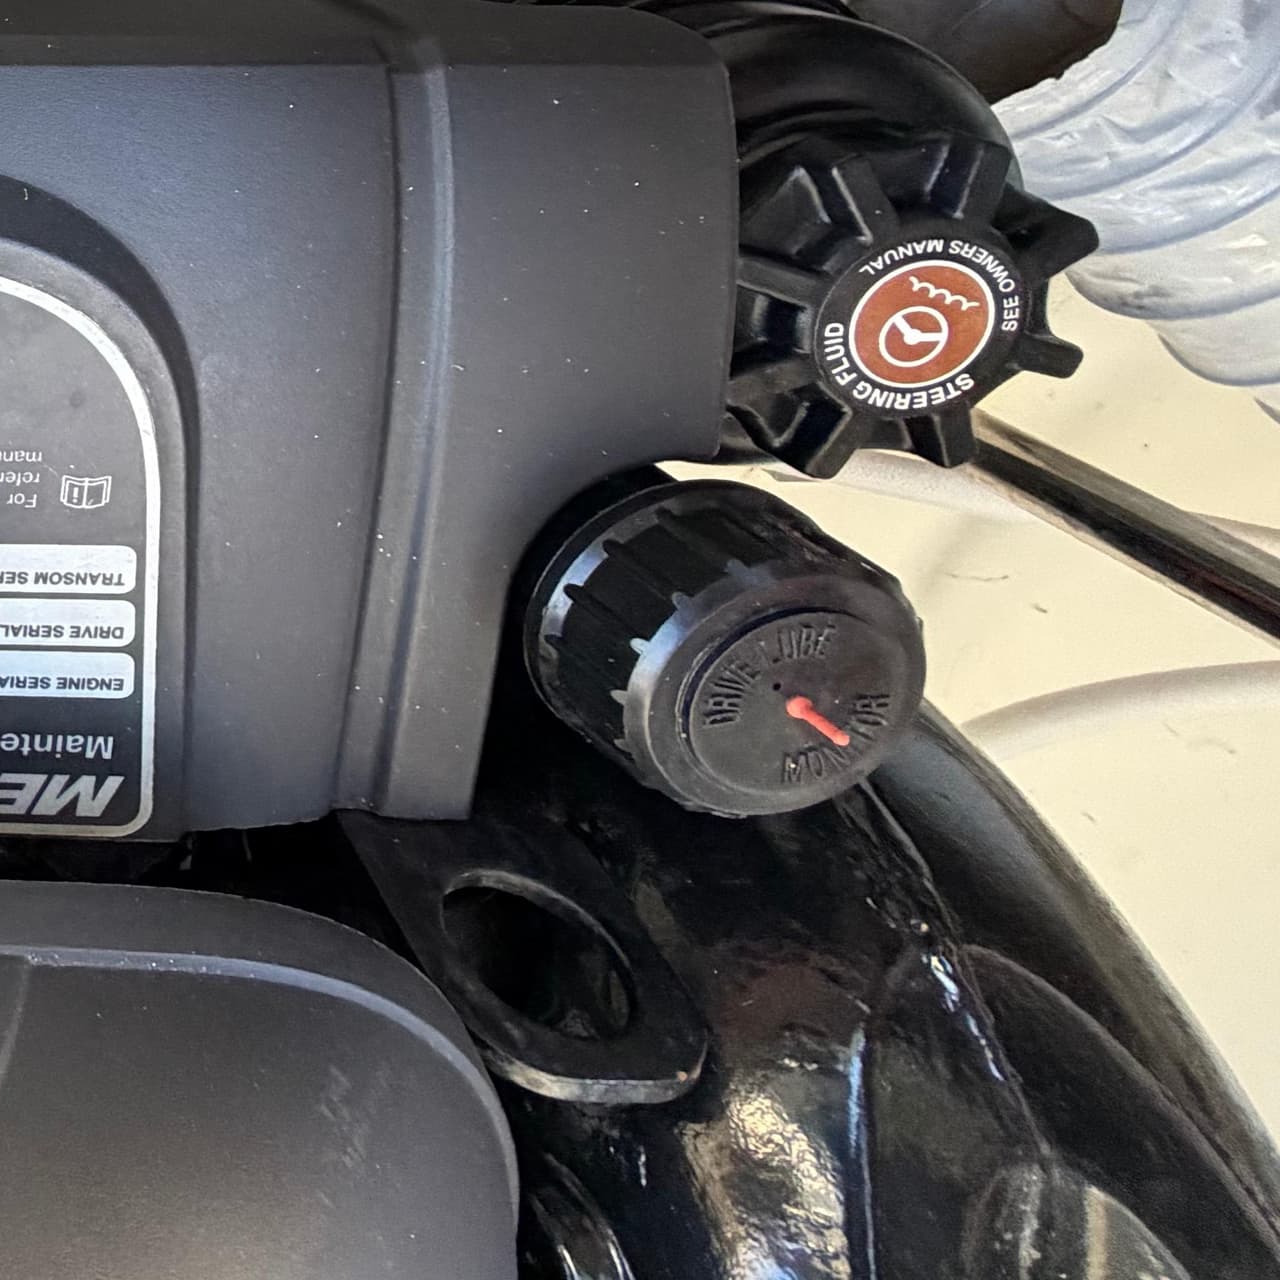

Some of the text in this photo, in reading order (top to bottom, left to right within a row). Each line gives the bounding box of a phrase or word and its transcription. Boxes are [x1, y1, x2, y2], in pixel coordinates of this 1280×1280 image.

[858, 238, 1020, 332] SEE OWNERS MANUAL
[822, 321, 975, 411] STEERING FLUID
[34, 571, 125, 586] TRANSOM
[0, 624, 65, 639] SERIAL
[69, 625, 124, 639] DRIVE
[56, 677, 124, 691] ENGINE
